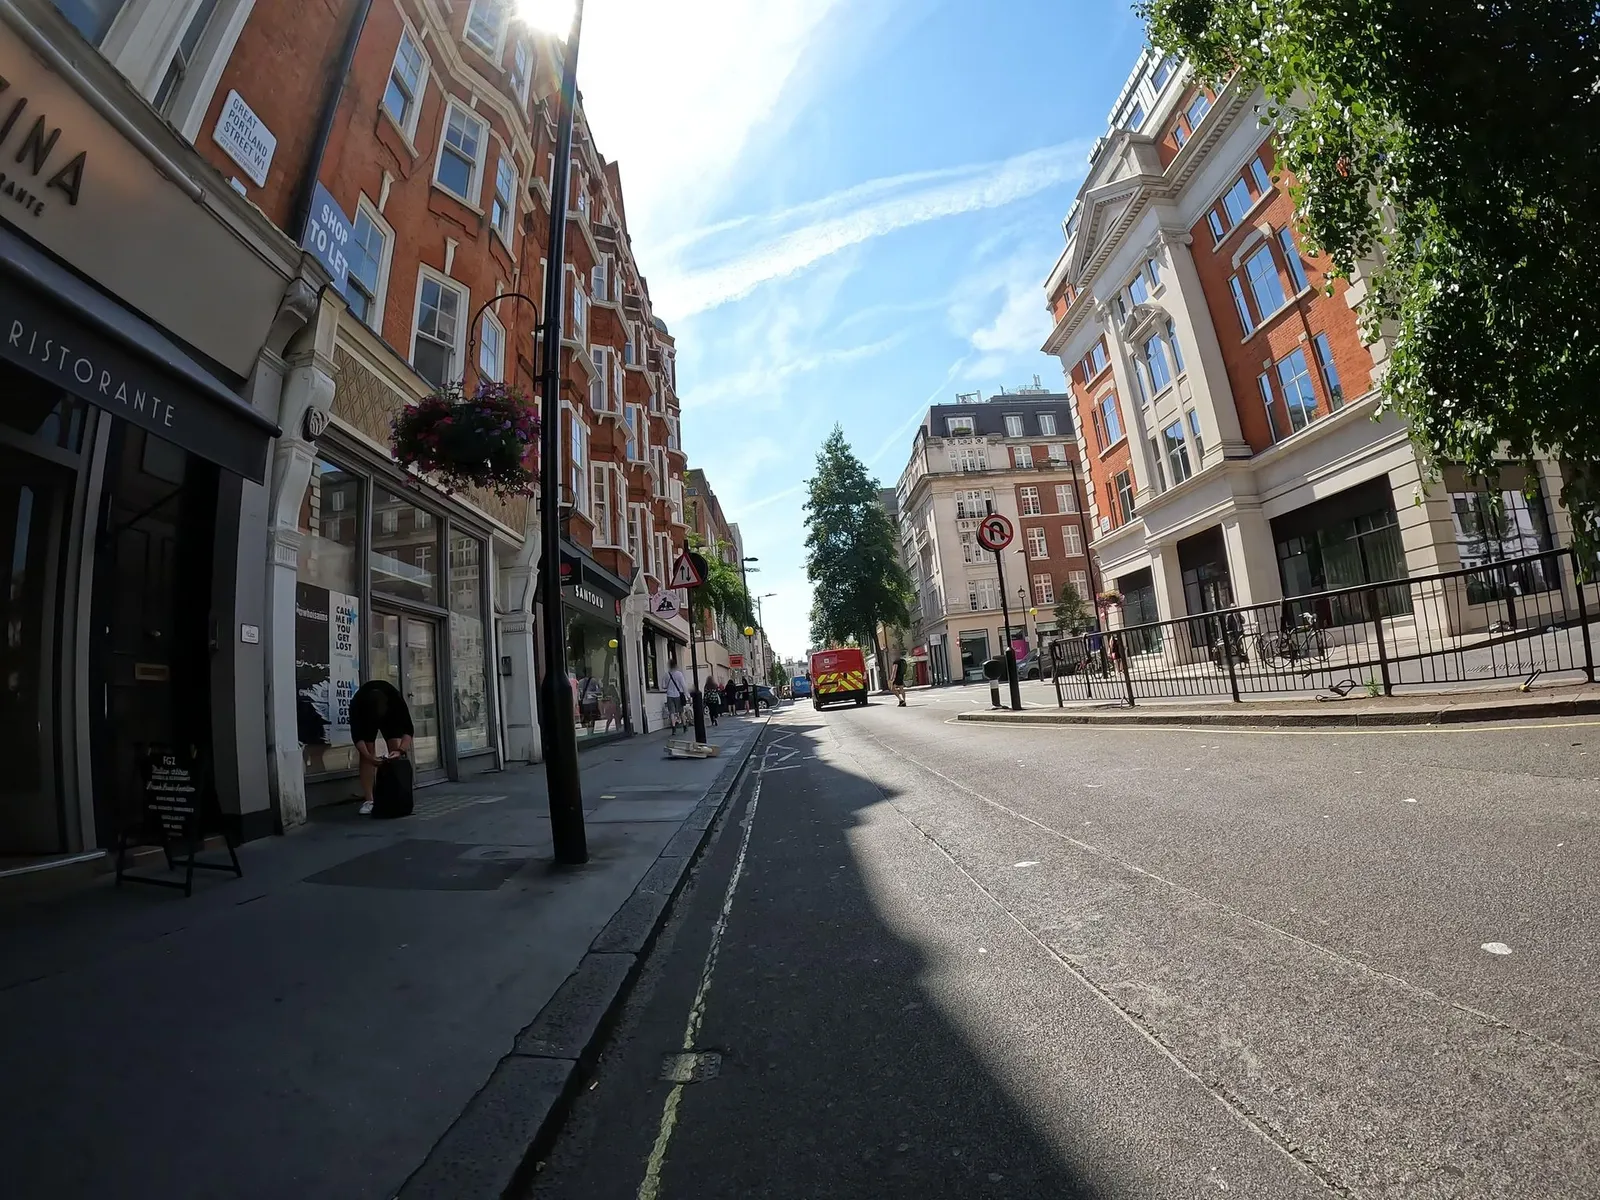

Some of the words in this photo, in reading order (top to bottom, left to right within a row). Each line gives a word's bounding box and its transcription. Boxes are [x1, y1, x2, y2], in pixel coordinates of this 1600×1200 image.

[232, 98, 258, 130] GREAT
[228, 109, 268, 158] PORTLAND
[0, 75, 88, 206] INA
[219, 136, 230, 148] CITY
[223, 121, 254, 157] STREET
[254, 152, 266, 171] W1
[321, 203, 348, 246] SHOP
[310, 218, 327, 253] TO
[327, 241, 349, 280] LET
[8, 319, 175, 427] RISTORANTE
[575, 584, 604, 609] SANTOKU
[336, 605, 352, 617] CALL
[335, 615, 346, 624] ME
[346, 617, 353, 625] IF
[336, 624, 351, 634] YOU
[337, 633, 350, 642] GET
[335, 641, 352, 652] LOST
[336, 680, 352, 689] CALL
[335, 689, 346, 698] ME
[347, 690, 353, 698] IF
[337, 698, 351, 707] YOU
[337, 716, 351, 725] LOS
